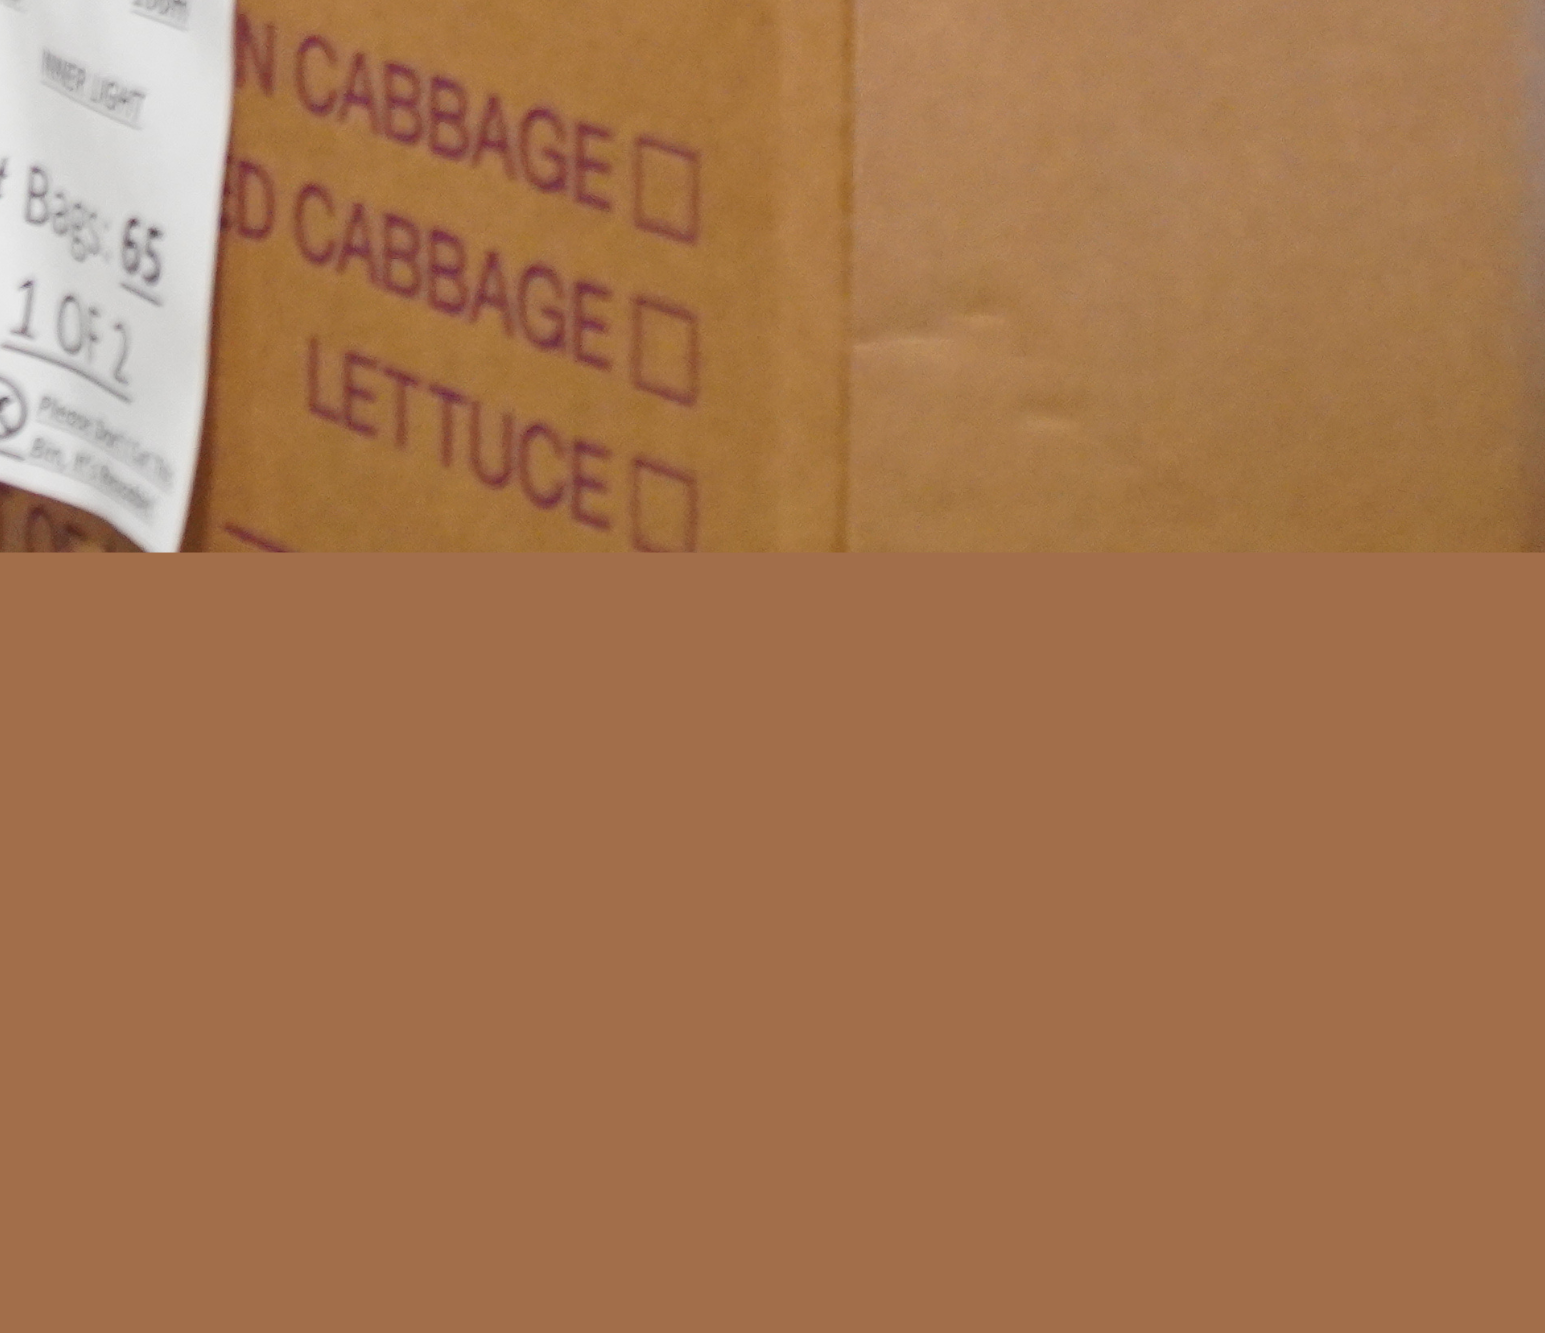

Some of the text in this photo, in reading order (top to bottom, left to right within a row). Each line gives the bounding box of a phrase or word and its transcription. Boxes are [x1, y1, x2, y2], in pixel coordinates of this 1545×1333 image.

[295, 35, 614, 212] CABBAGE
[10, 279, 35, 341] 1
[113, 322, 131, 385] 2
[121, 217, 164, 288] 65
[294, 184, 612, 370] CABBAGE
[308, 336, 612, 530] LETTUCE
